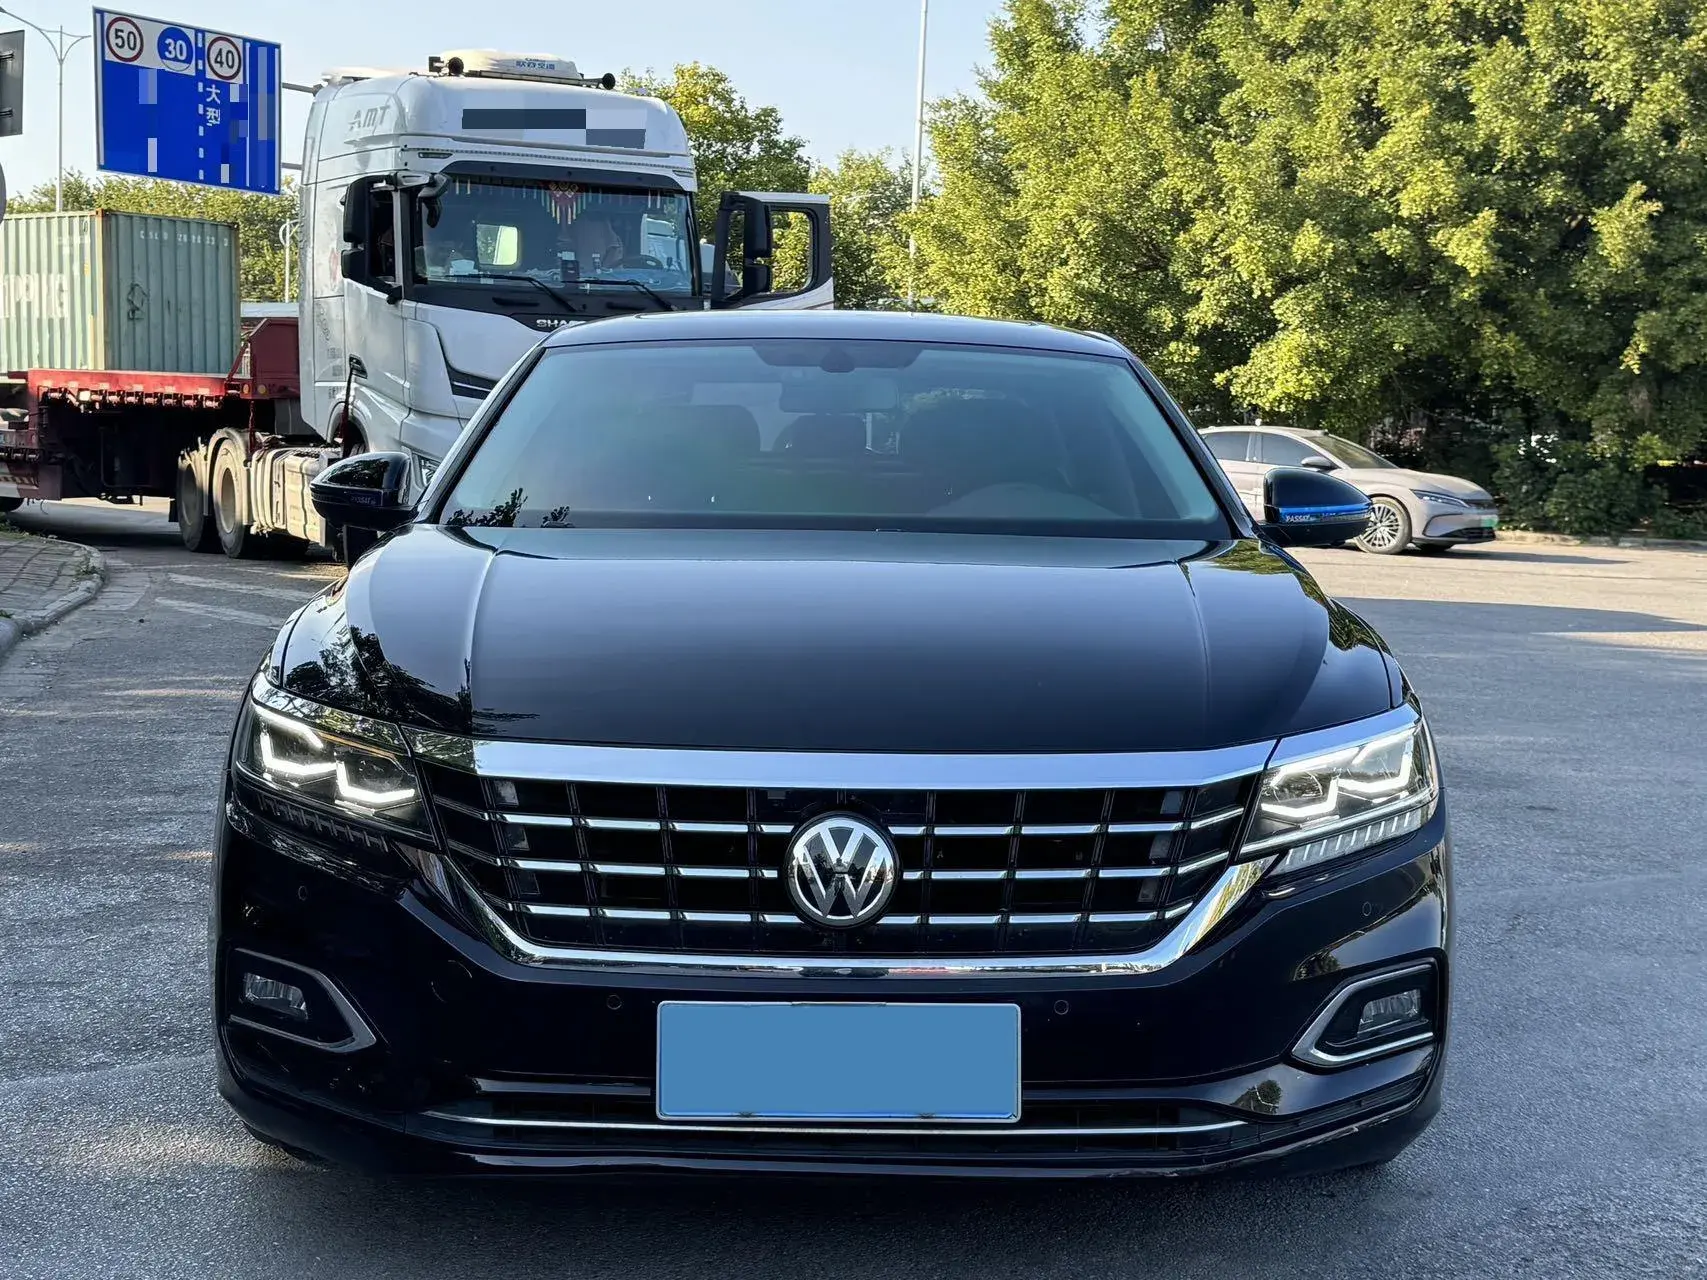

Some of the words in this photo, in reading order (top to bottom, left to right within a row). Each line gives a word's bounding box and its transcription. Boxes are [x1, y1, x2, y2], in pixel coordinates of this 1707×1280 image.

[114, 28, 138, 52] 50
[163, 38, 188, 61] 30
[214, 48, 236, 70] 40
[206, 84, 221, 127] 大型
